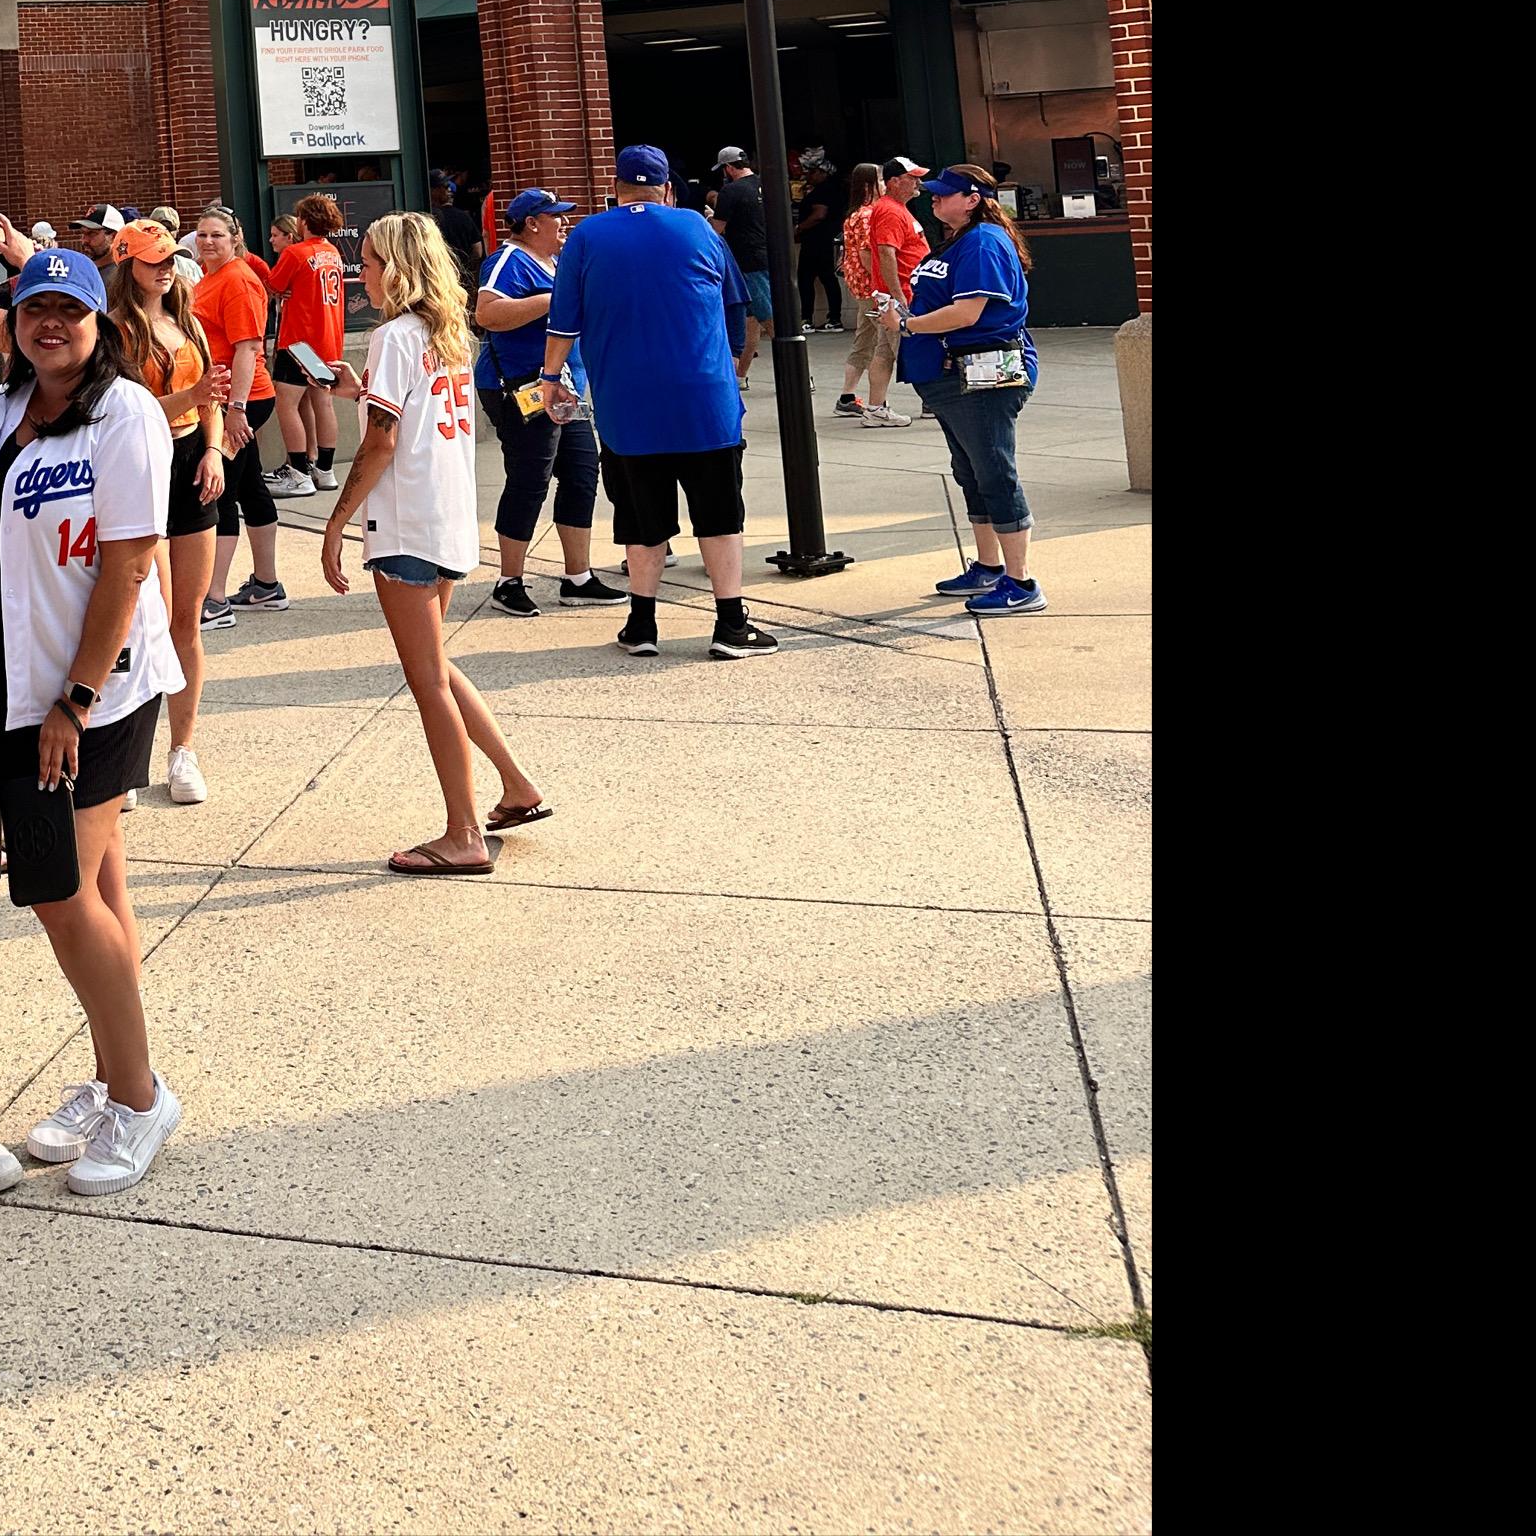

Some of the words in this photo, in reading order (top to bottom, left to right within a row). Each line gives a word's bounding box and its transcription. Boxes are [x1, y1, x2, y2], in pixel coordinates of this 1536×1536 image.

[270, 19, 370, 41] HUNGRY?
[276, 47, 293, 55] YOUR
[323, 46, 346, 54] ORIOLE
[308, 123, 345, 131] Download
[306, 131, 366, 149] Ballpark
[47, 255, 69, 277] LA
[320, 268, 340, 305] 13
[431, 373, 470, 440] 35
[14, 458, 95, 520] dgers
[58, 517, 97, 567] 14
